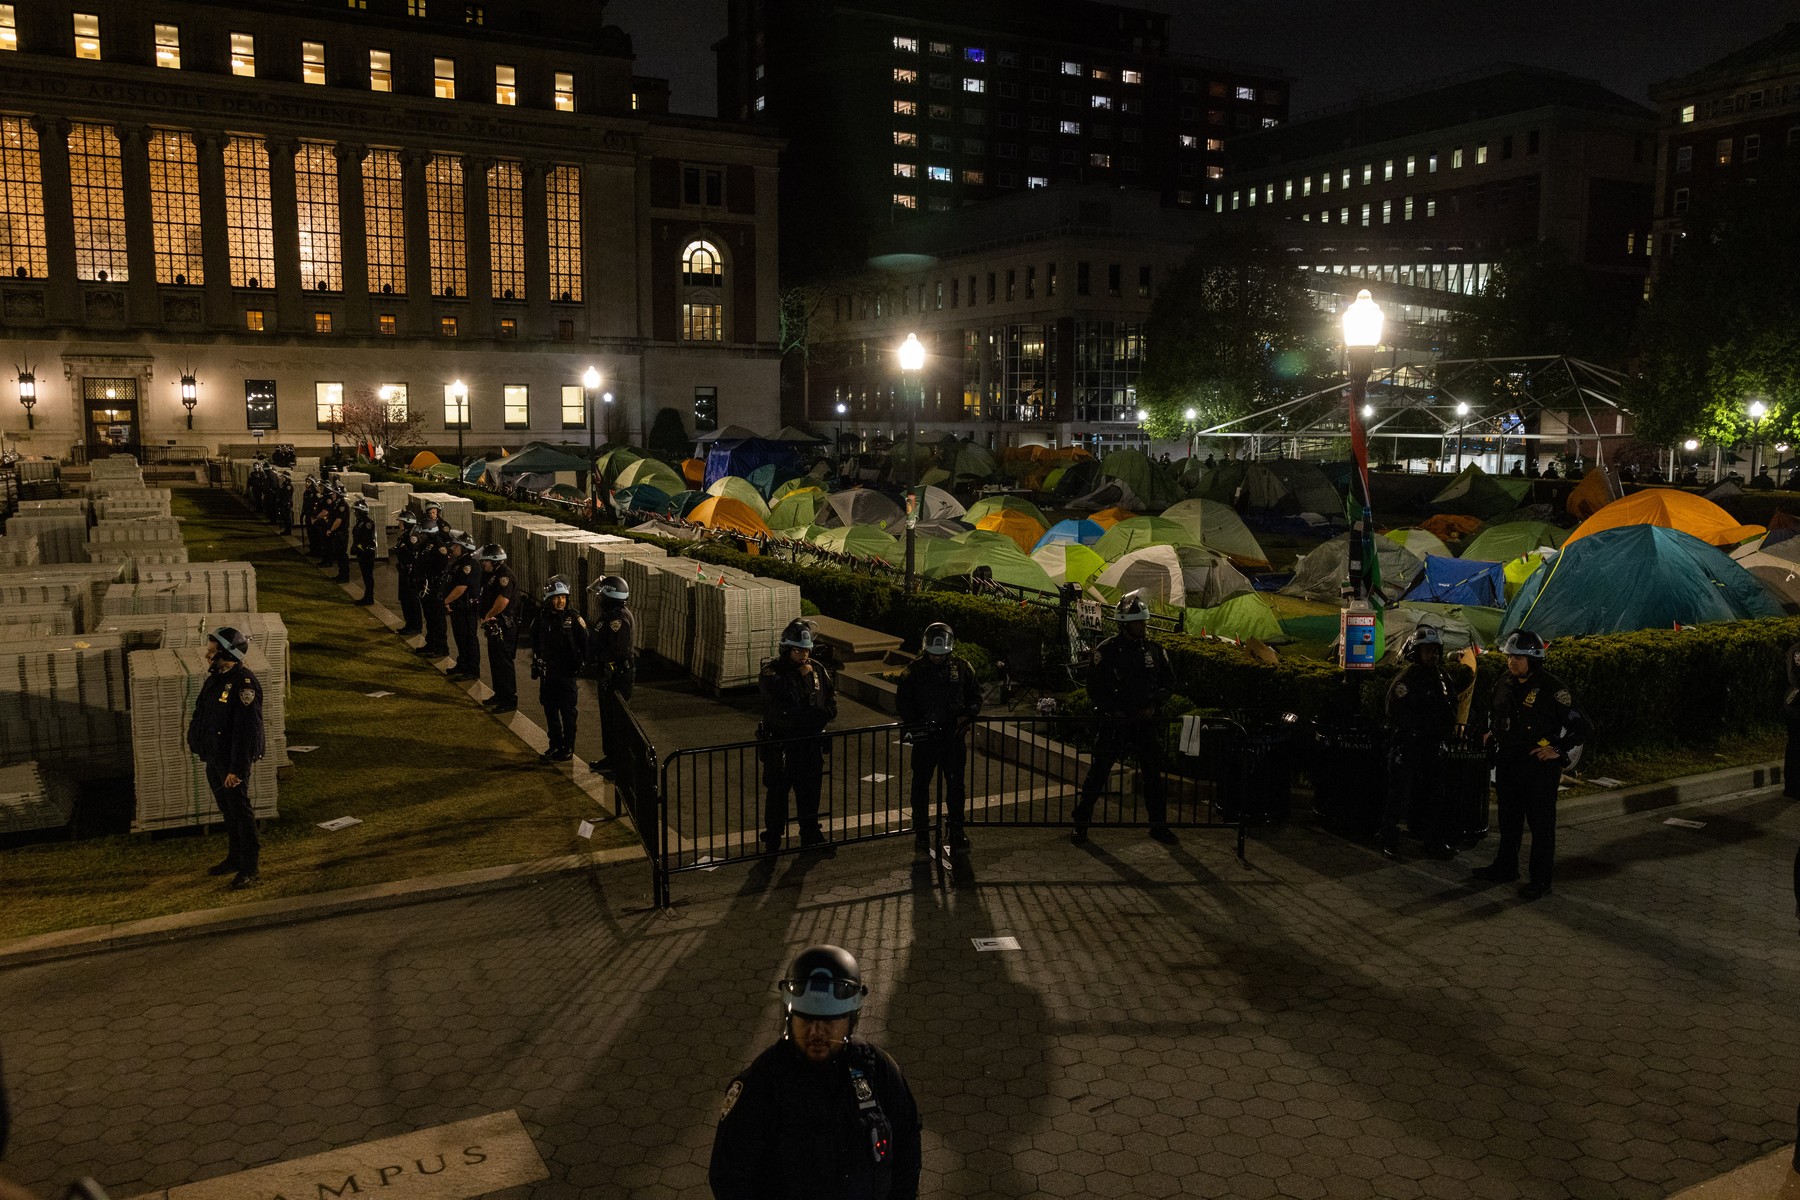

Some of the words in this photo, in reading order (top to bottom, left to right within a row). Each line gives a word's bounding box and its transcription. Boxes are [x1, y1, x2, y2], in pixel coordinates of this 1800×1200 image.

[87, 83, 206, 107] ARISTOTLE
[221, 98, 368, 125] DEMOSTHENES
[382, 113, 451, 134] CICERO
[1340, 741, 1373, 750] TRASH
[272, 1145, 488, 1200] MPUS
